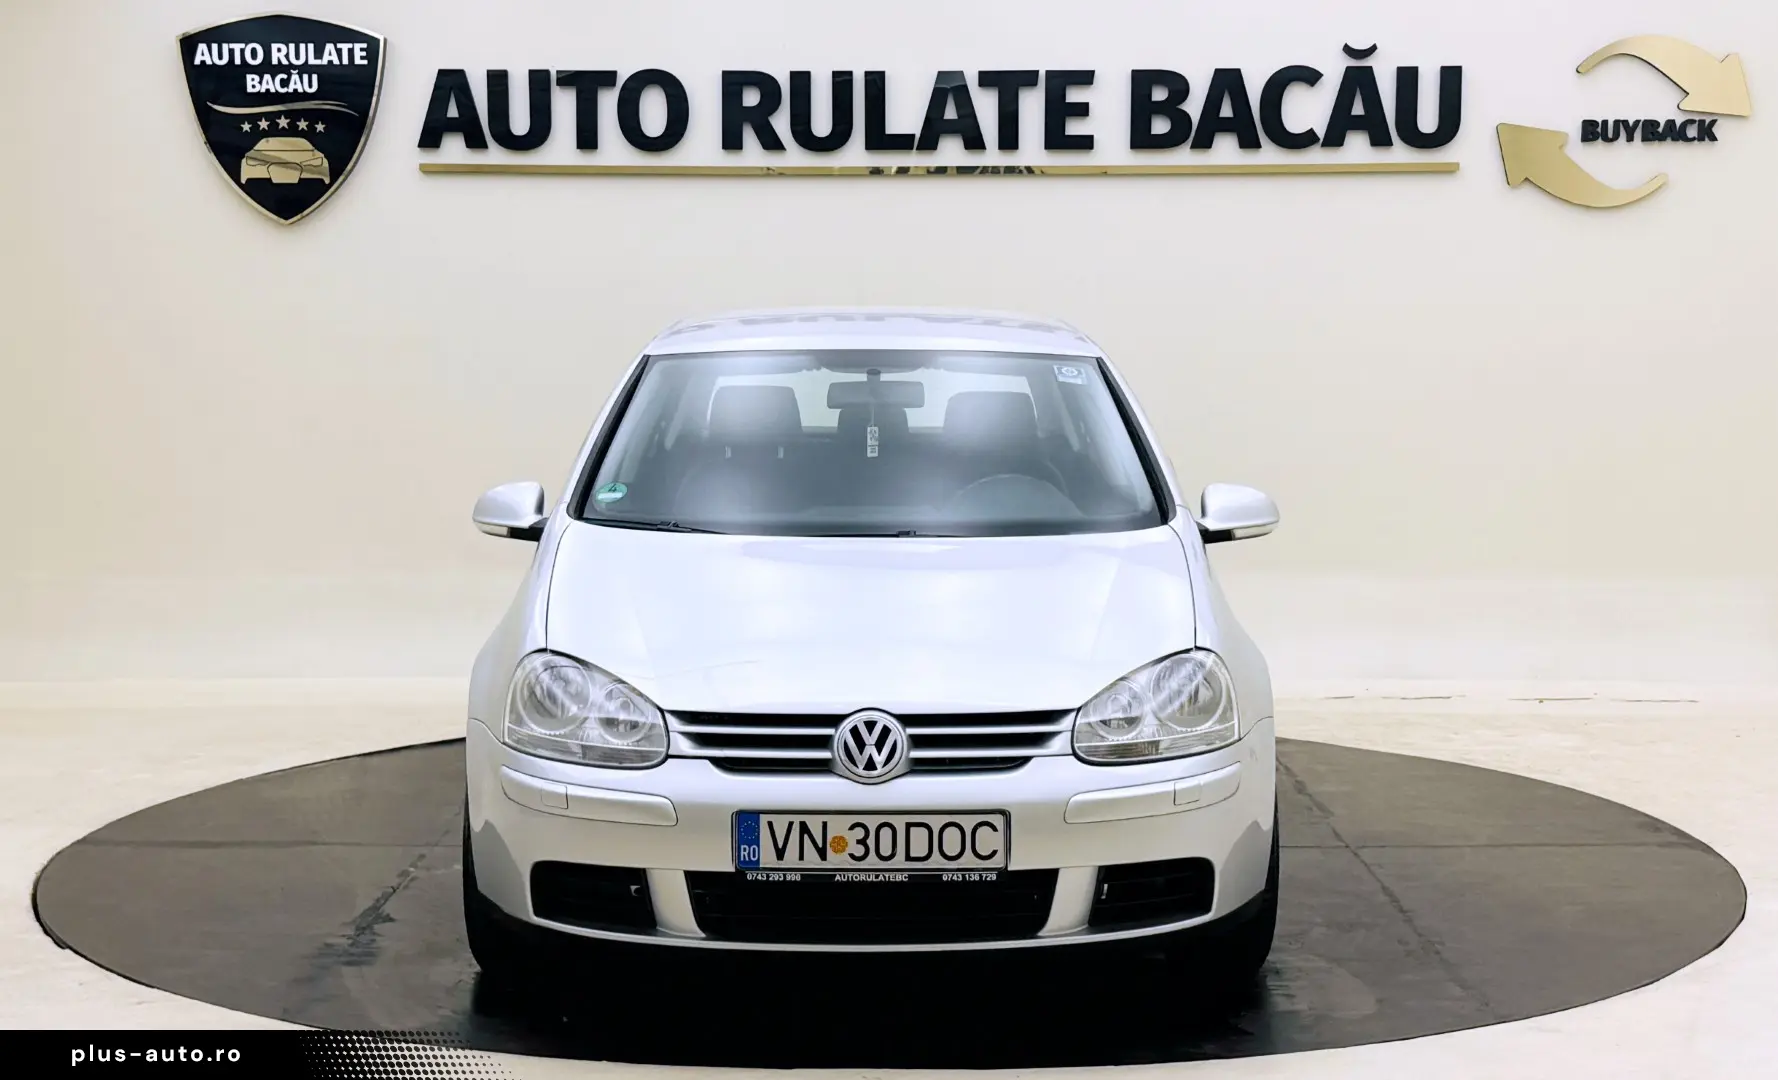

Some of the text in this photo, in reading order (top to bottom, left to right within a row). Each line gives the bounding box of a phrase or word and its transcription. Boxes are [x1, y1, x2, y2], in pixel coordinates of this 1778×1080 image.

[194, 42, 368, 66] AUTO RULATE
[245, 70, 319, 94] BACĂU
[417, 43, 1463, 152] AUTO RULATE BACĂU
[1580, 118, 1719, 143] BUYBACK
[740, 844, 759, 861] RO
[766, 820, 828, 862] VN
[746, 873, 767, 881] 0743
[834, 873, 909, 882] AUTORULATEBC
[942, 873, 962, 881] 0743
[982, 873, 997, 881] 729
